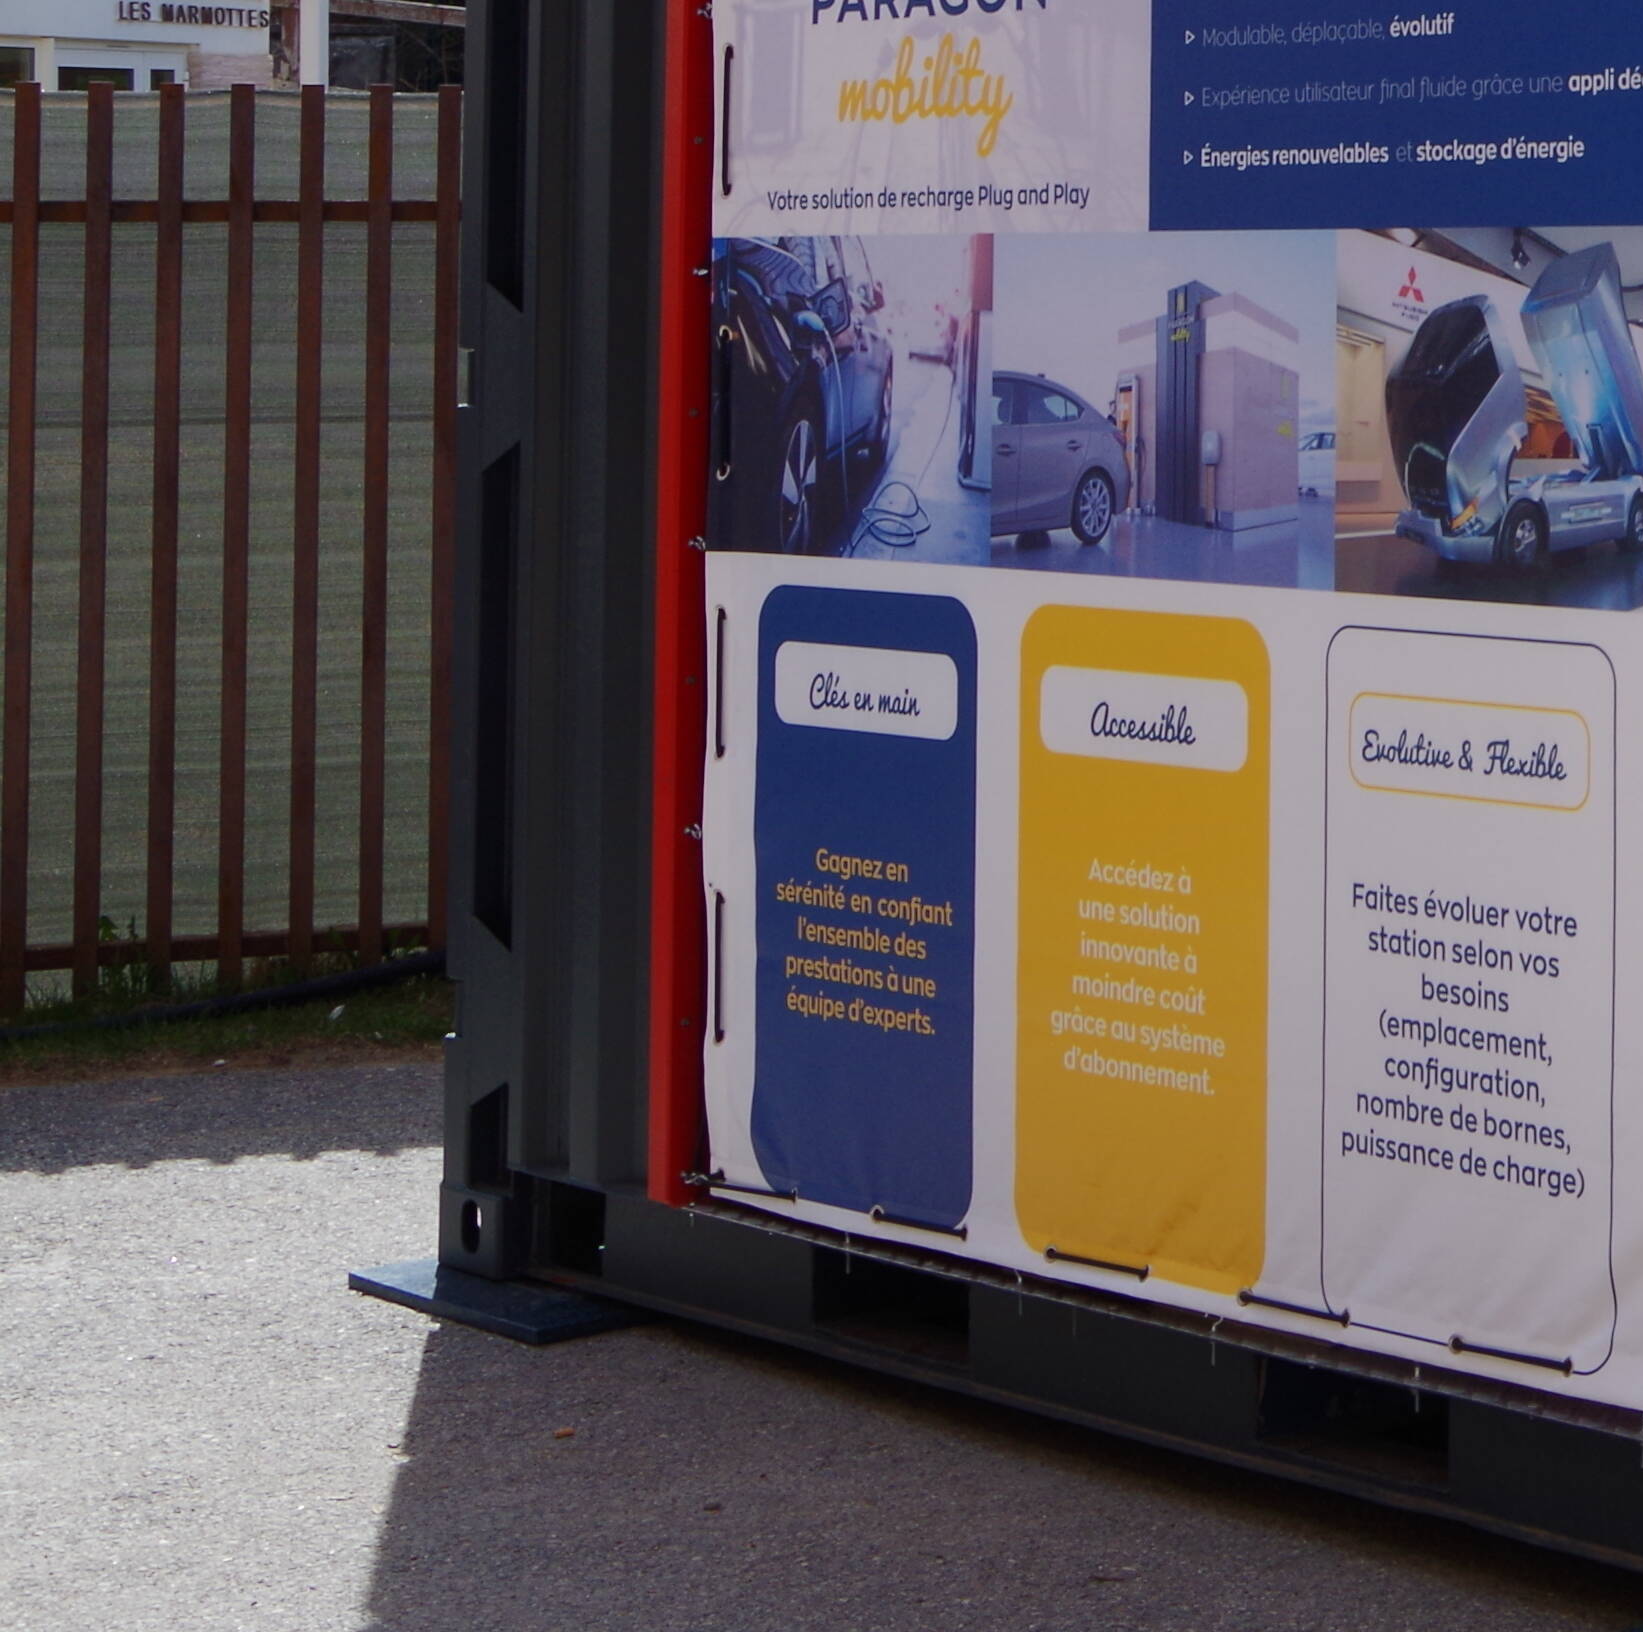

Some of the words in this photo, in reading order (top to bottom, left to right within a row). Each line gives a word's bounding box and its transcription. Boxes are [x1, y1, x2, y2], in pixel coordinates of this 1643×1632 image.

[119, 0, 151, 21] LES
[161, 3, 269, 28] MARMOTTES
[1203, 23, 1287, 47] Modulable,
[1291, 18, 1385, 45] déplaçable,
[1390, 12, 1454, 37] évolutif
[838, 32, 1013, 158] mobility
[1202, 85, 1290, 110] Expérience
[1295, 81, 1375, 103] utilisateur
[1379, 77, 1415, 104] final
[1419, 75, 1467, 103] fluide
[1472, 73, 1523, 100] grâce
[1529, 76, 1563, 93] une
[1568, 68, 1614, 96] appli
[1201, 143, 1270, 171] Énergies
[1273, 142, 1389, 165] renouvelables
[1396, 141, 1413, 162] et
[1416, 139, 1497, 165] stockage
[1500, 135, 1584, 163] d'énergie
[767, 190, 808, 211] Votre
[812, 187, 873, 210] solution
[877, 186, 897, 208] de
[901, 186, 974, 211] recharge
[978, 184, 1013, 210] Plug
[1018, 183, 1049, 205] and
[1054, 183, 1090, 209] Play
[809, 672, 850, 710] Clés
[854, 692, 874, 712] en
[878, 689, 920, 716] main
[1091, 702, 1196, 745] Accessible
[1362, 729, 1454, 769] Evolutive
[1458, 740, 1473, 772] &
[1483, 739, 1567, 781] Flexible
[816, 848, 883, 880] Gagnez
[885, 863, 908, 883] en
[1088, 858, 1174, 892] Accédez
[1176, 866, 1192, 894] à
[777, 878, 846, 910] sérénité
[850, 894, 872, 914] en
[877, 896, 953, 926] confiant
[1078, 899, 1118, 922] une
[1119, 902, 1200, 934] solution
[1353, 883, 1418, 916] Faites
[1424, 890, 1509, 928] évoluer
[1515, 907, 1577, 937] votre
[798, 916, 891, 953] l'ensemble
[893, 932, 926, 960] des
[1081, 936, 1181, 971] innovante
[1183, 943, 1198, 974] à
[1369, 926, 1445, 961] station
[1452, 940, 1513, 971] selon
[1519, 953, 1559, 978] vos
[786, 956, 884, 996] prestations
[887, 965, 899, 992] à
[902, 975, 936, 998] une
[1072, 973, 1156, 1006] moindre
[1158, 986, 1206, 1016] coût
[1422, 973, 1509, 1012] besoins
[787, 985, 846, 1021] équipe
[848, 998, 935, 1035] d'experts.
[1051, 1006, 1109, 1037] grâce
[1110, 1020, 1137, 1043] au
[1138, 1024, 1226, 1058] système
[1379, 1009, 1552, 1066] (emplacement,
[1063, 1045, 1215, 1095] d'abonnement.
[1385, 1057, 1545, 1107] configuration,
[1357, 1093, 1443, 1127] nombre
[1450, 1104, 1477, 1133] de
[1484, 1108, 1570, 1155] bornes,
[1342, 1129, 1453, 1170] puissance
[1459, 1147, 1487, 1177] de
[1493, 1155, 1585, 1198] charge)
